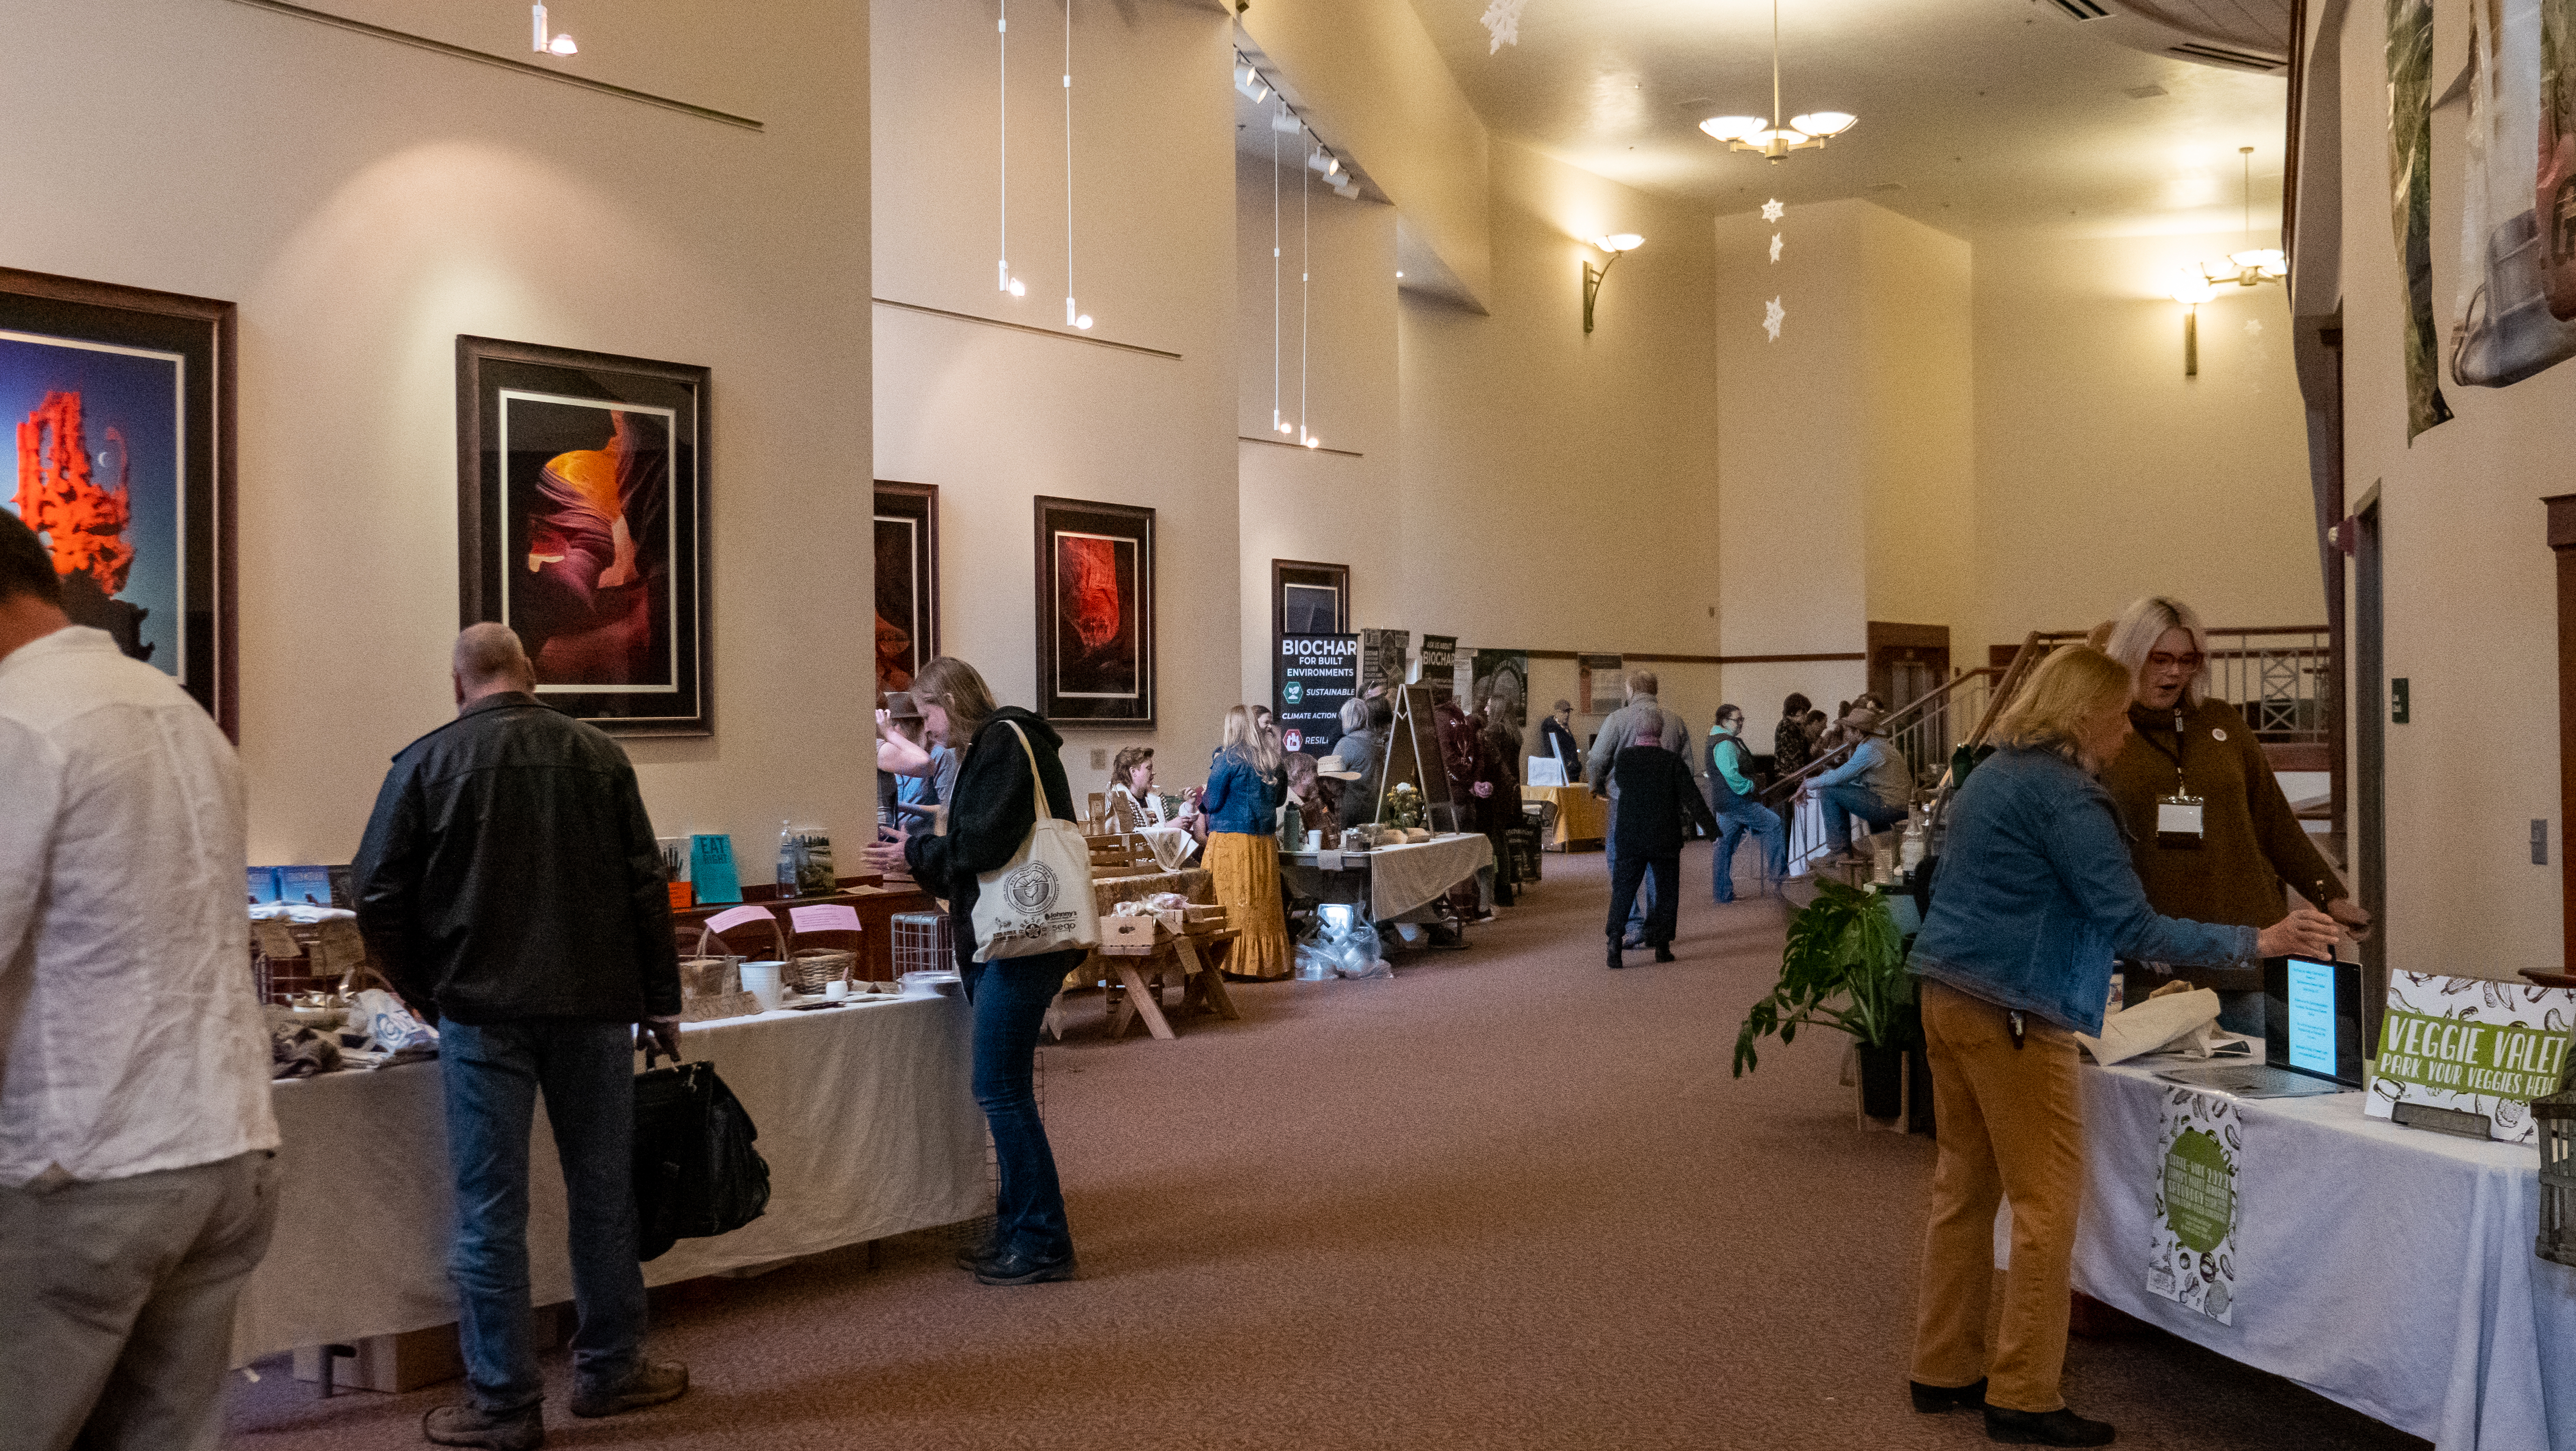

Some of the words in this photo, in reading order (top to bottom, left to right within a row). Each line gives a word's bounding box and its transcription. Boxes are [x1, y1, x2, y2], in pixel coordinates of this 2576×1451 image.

[1283, 640, 1357, 655] BIOCHAR
[1423, 651, 1455, 666] BIOCHAR
[1287, 668, 1354, 677] ENVIRONMENTS
[700, 837, 724, 854] EAT
[2387, 1015, 2485, 1064] VEGGIE
[2493, 1031, 2567, 1074] VALET
[2380, 1053, 2422, 1079] PARK
[2428, 1061, 2462, 1085] YOUR
[2467, 1067, 2523, 1094] VEGGIES
